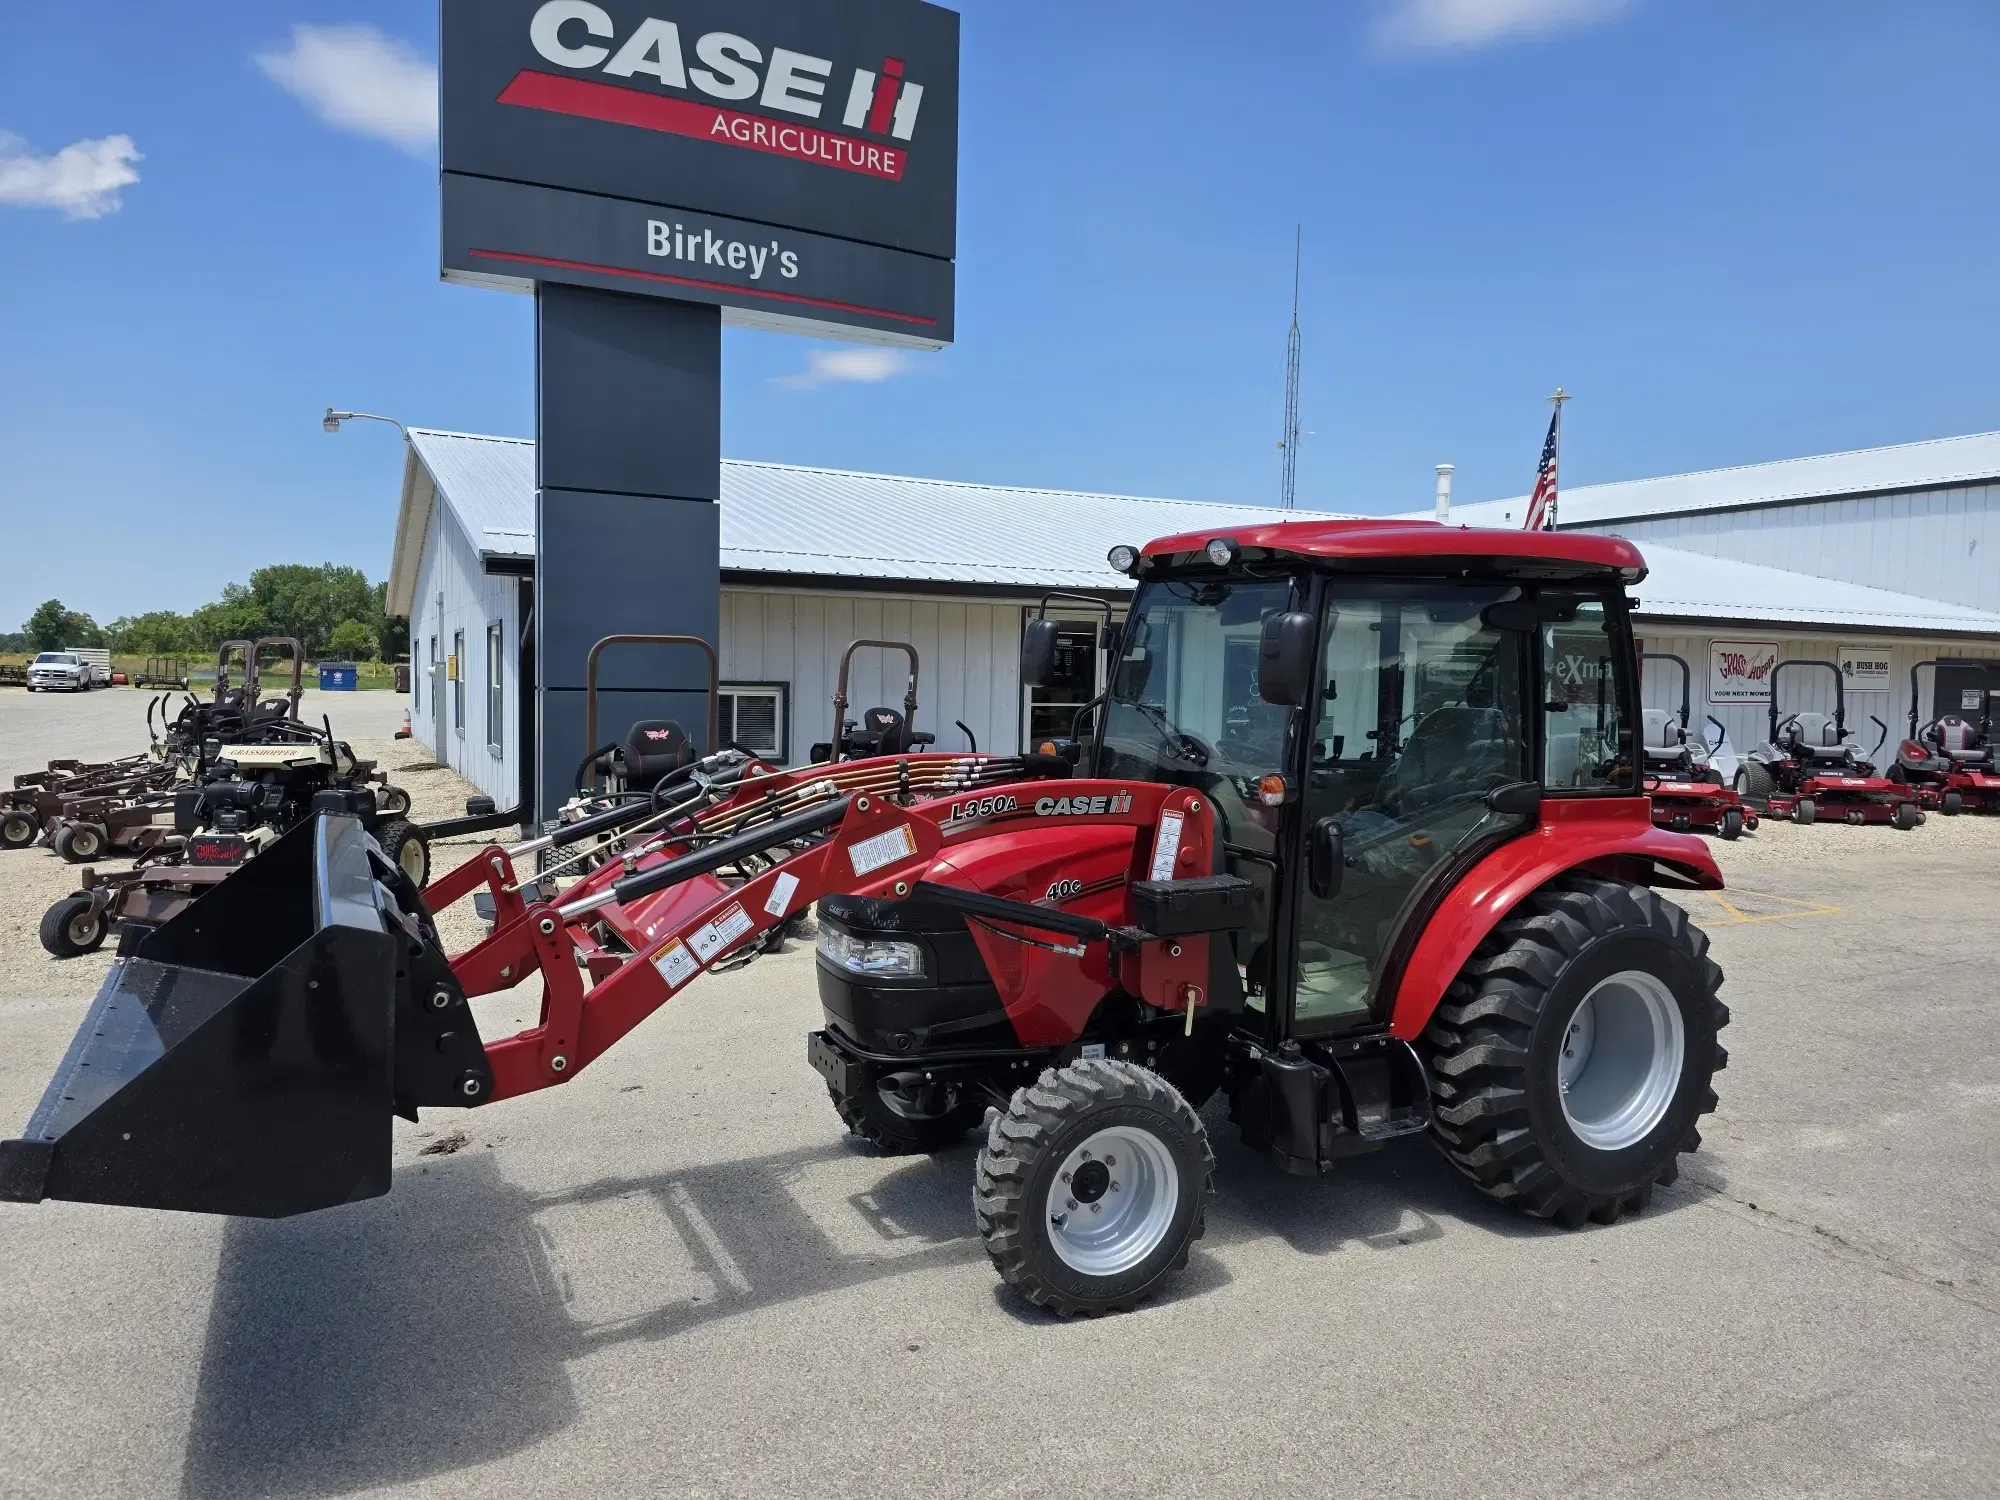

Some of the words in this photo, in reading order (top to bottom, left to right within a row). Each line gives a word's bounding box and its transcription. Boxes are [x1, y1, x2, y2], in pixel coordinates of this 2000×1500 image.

[530, 0, 832, 118] CASE
[711, 114, 896, 174] AGRICULTURE
[647, 219, 800, 280] Birkey's
[1856, 661, 1873, 670] BUSH
[1874, 661, 1889, 670] HOG
[230, 749, 298, 757] GRASSHOPPER
[951, 795, 1018, 822] L350A
[1034, 796, 1106, 815] CASE
[718, 904, 739, 923] DANGER
